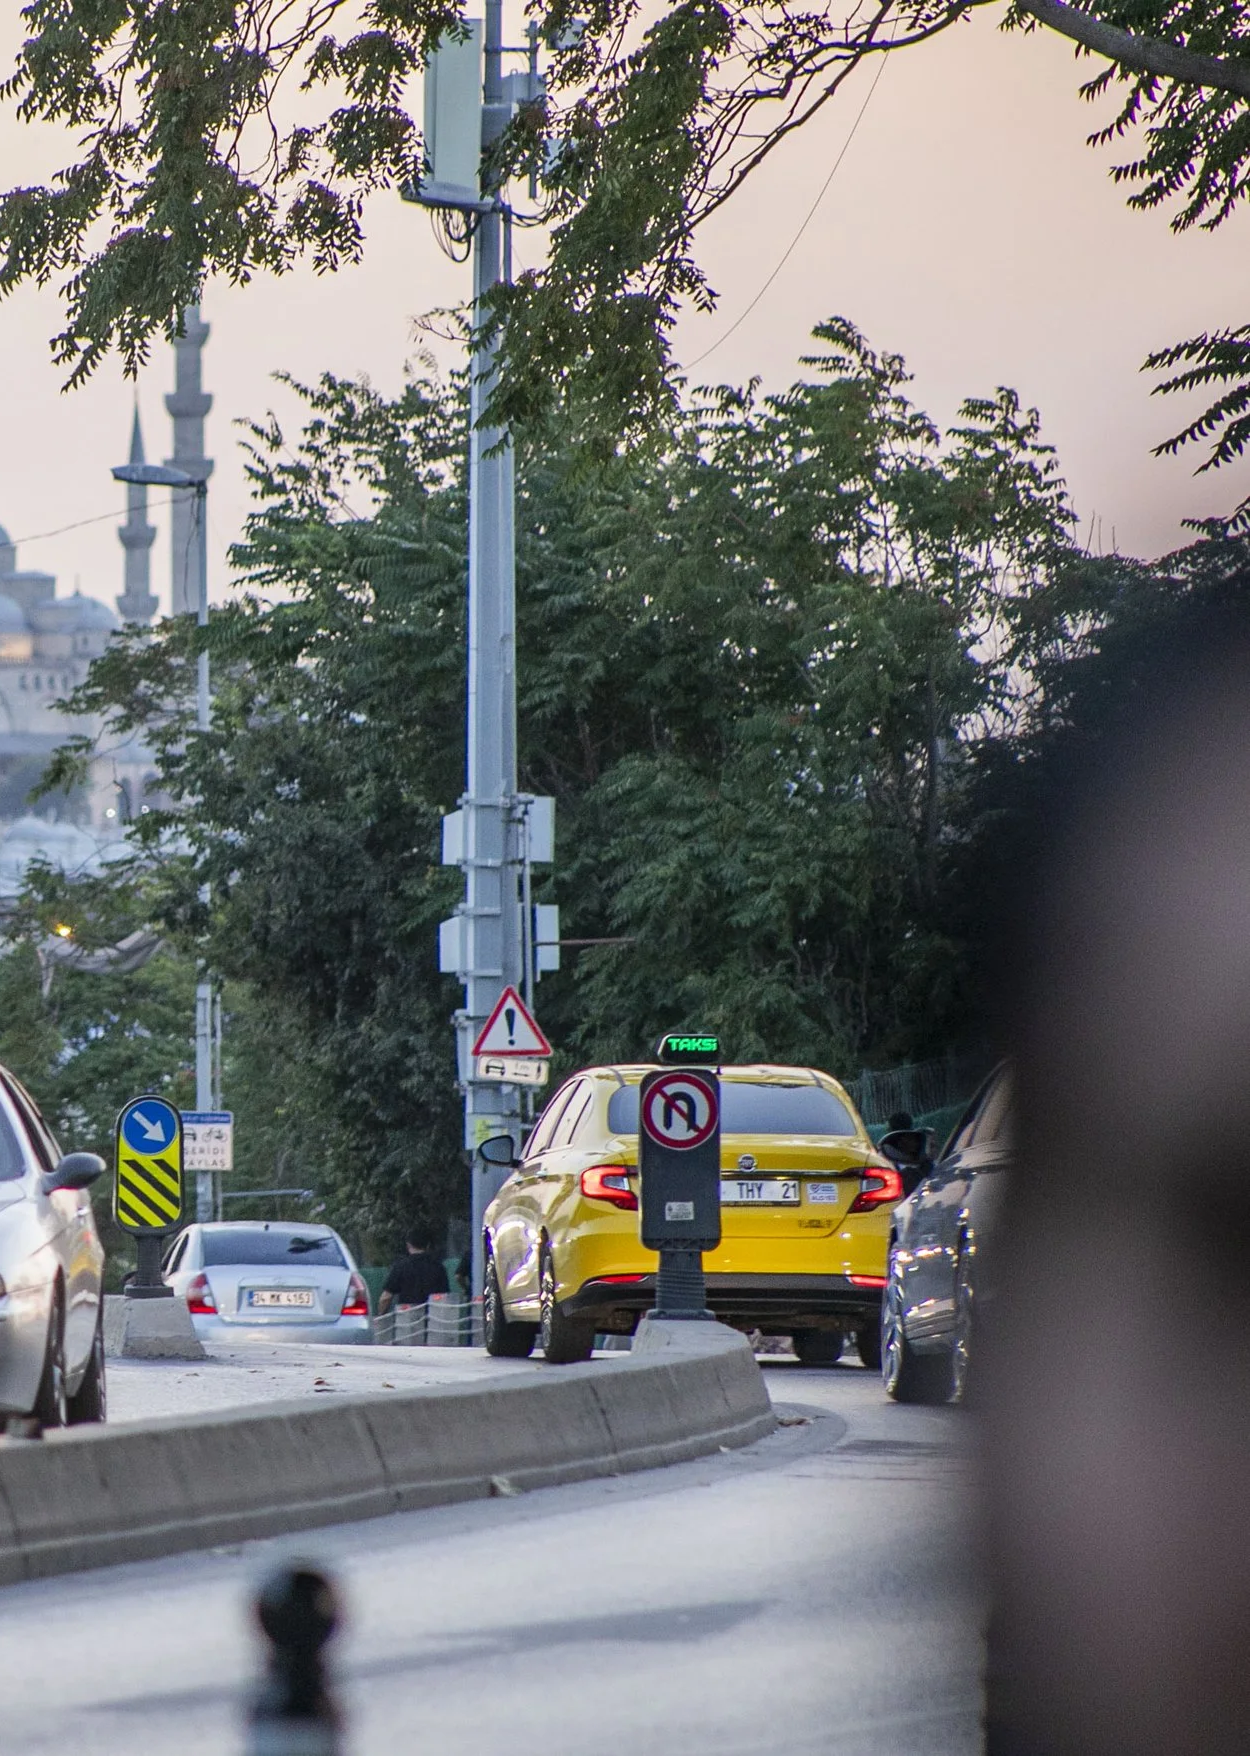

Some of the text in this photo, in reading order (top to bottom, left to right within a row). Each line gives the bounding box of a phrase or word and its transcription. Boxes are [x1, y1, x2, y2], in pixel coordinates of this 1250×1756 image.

[736, 1182, 798, 1199] THY 21
[253, 1293, 266, 1303] 34
